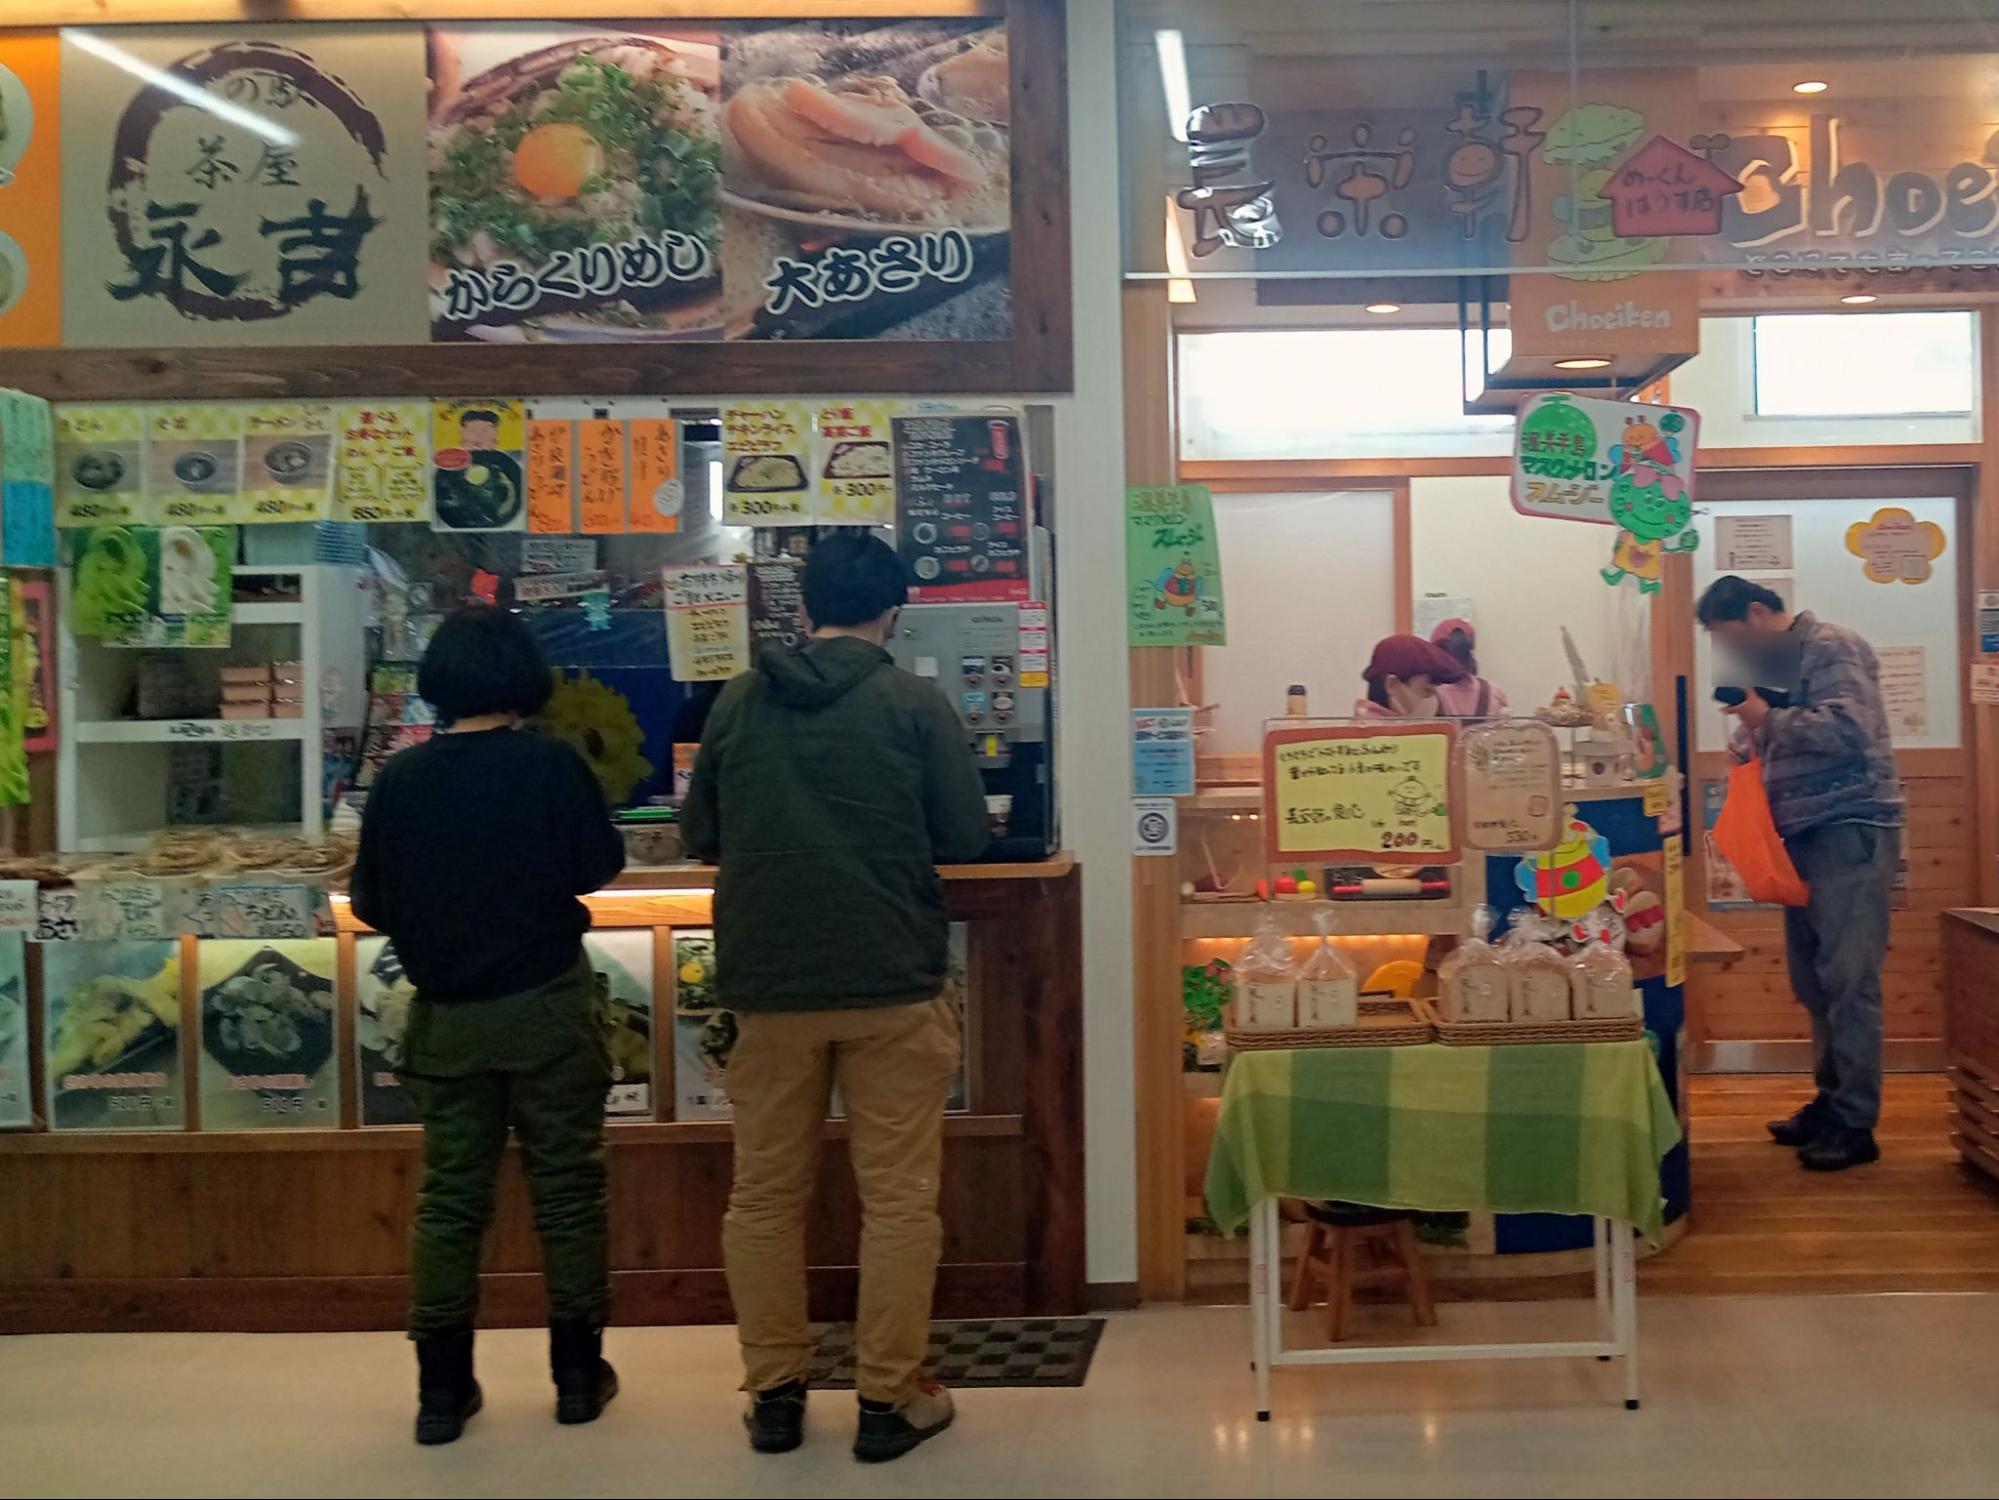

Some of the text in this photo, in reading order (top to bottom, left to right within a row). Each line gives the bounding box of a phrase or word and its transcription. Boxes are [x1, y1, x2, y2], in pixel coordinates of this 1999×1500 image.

[186, 135, 302, 188] 茶屋
[104, 198, 382, 300] 永吉
[445, 230, 710, 319] からくりめし
[766, 228, 973, 314] 大あさり
[1545, 300, 1671, 332] Choeiken
